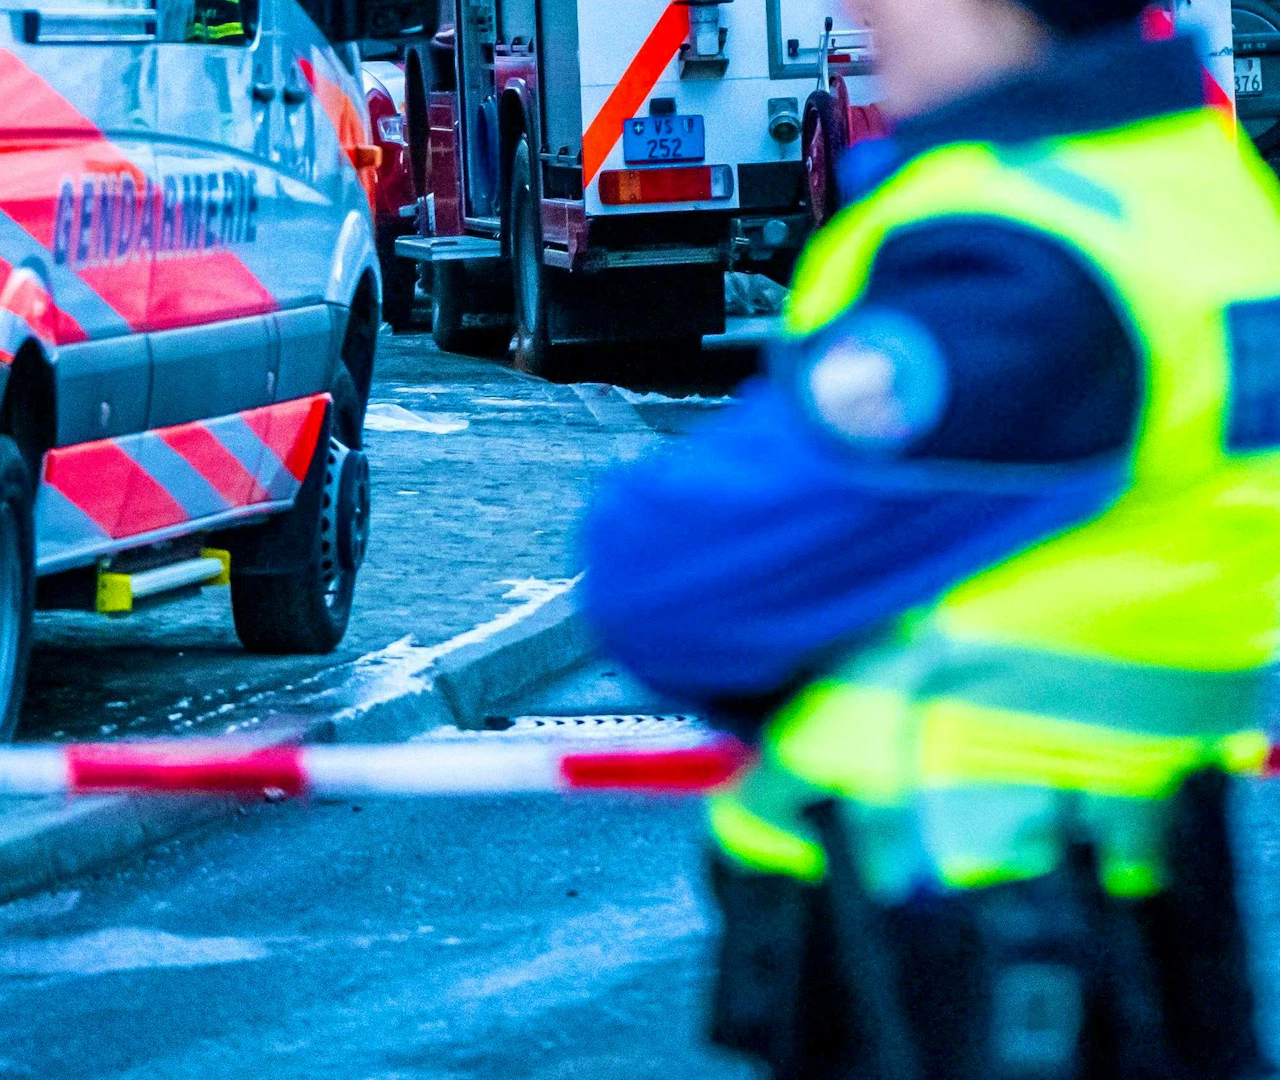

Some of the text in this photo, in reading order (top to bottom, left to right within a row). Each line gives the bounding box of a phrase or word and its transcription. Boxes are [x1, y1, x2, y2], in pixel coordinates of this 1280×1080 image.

[655, 119, 673, 135] VS
[647, 139, 682, 159] 252
[53, 171, 260, 266] GENDARMERIE
